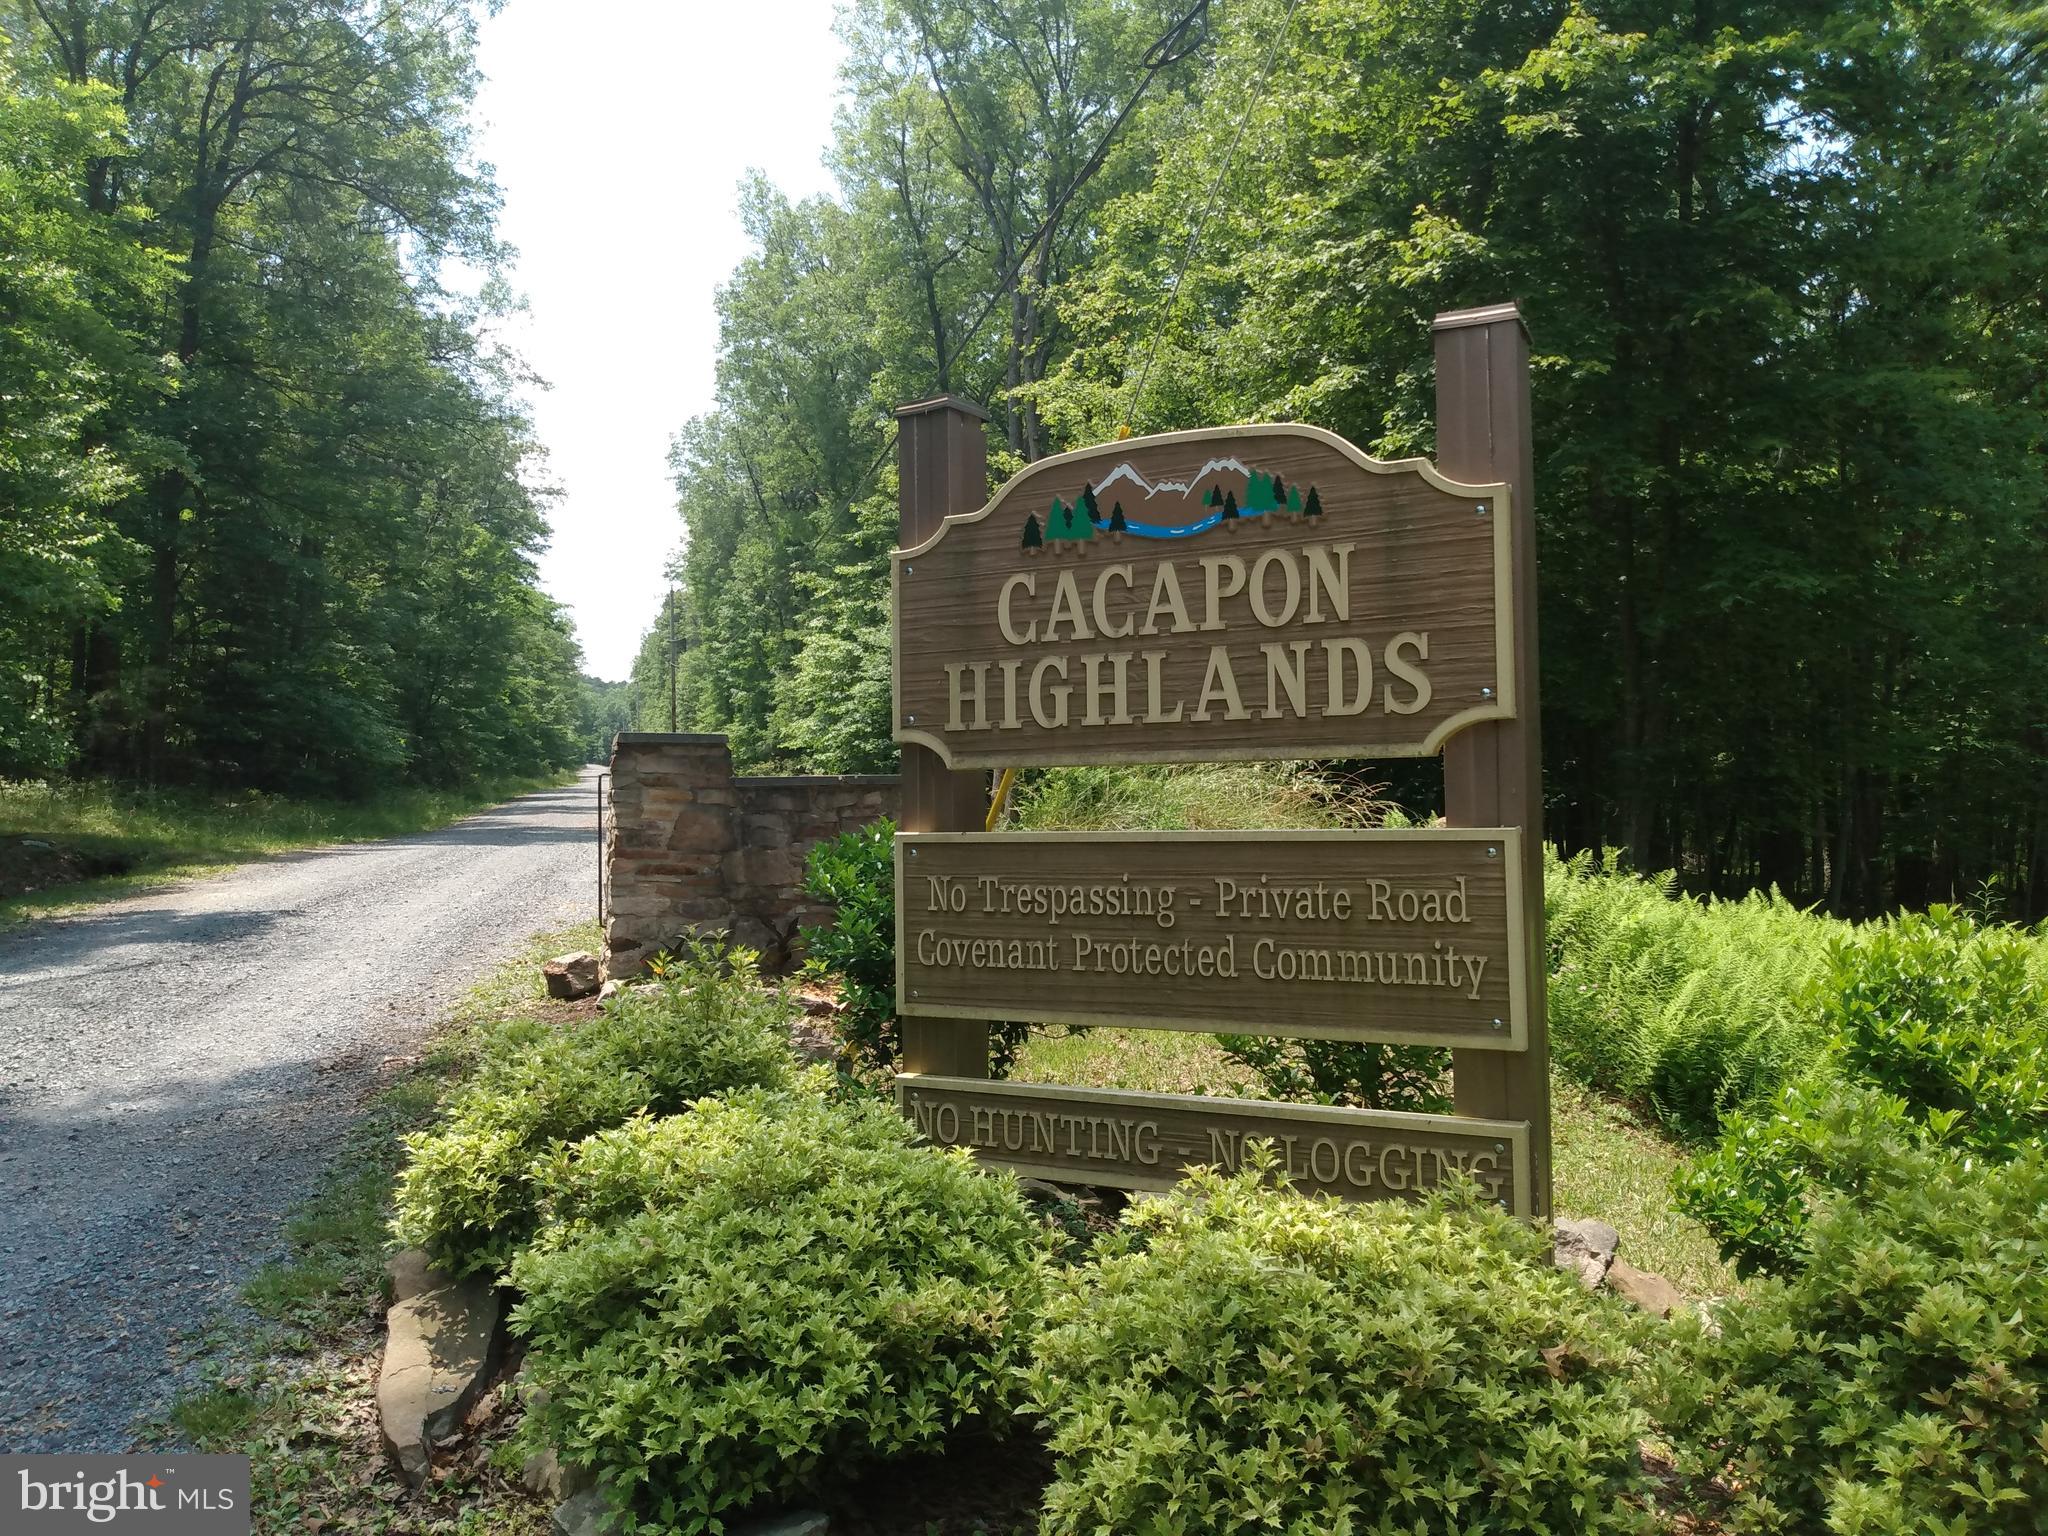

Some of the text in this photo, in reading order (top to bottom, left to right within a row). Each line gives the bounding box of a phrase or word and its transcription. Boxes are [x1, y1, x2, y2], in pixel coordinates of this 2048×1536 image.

[997, 542, 1355, 646] CACAPON
[943, 632, 1433, 731] HIGHLANDS
[927, 875, 967, 914] No
[977, 873, 1177, 928] Trespassing
[1214, 874, 1351, 920] Private
[1366, 875, 1472, 923] Road
[917, 928, 1488, 1000] Covenant Protected Community
[910, 1100, 961, 1144] NO
[969, 1105, 1163, 1166] HUNTING
[1280, 1135, 1504, 1200] LOGGING
